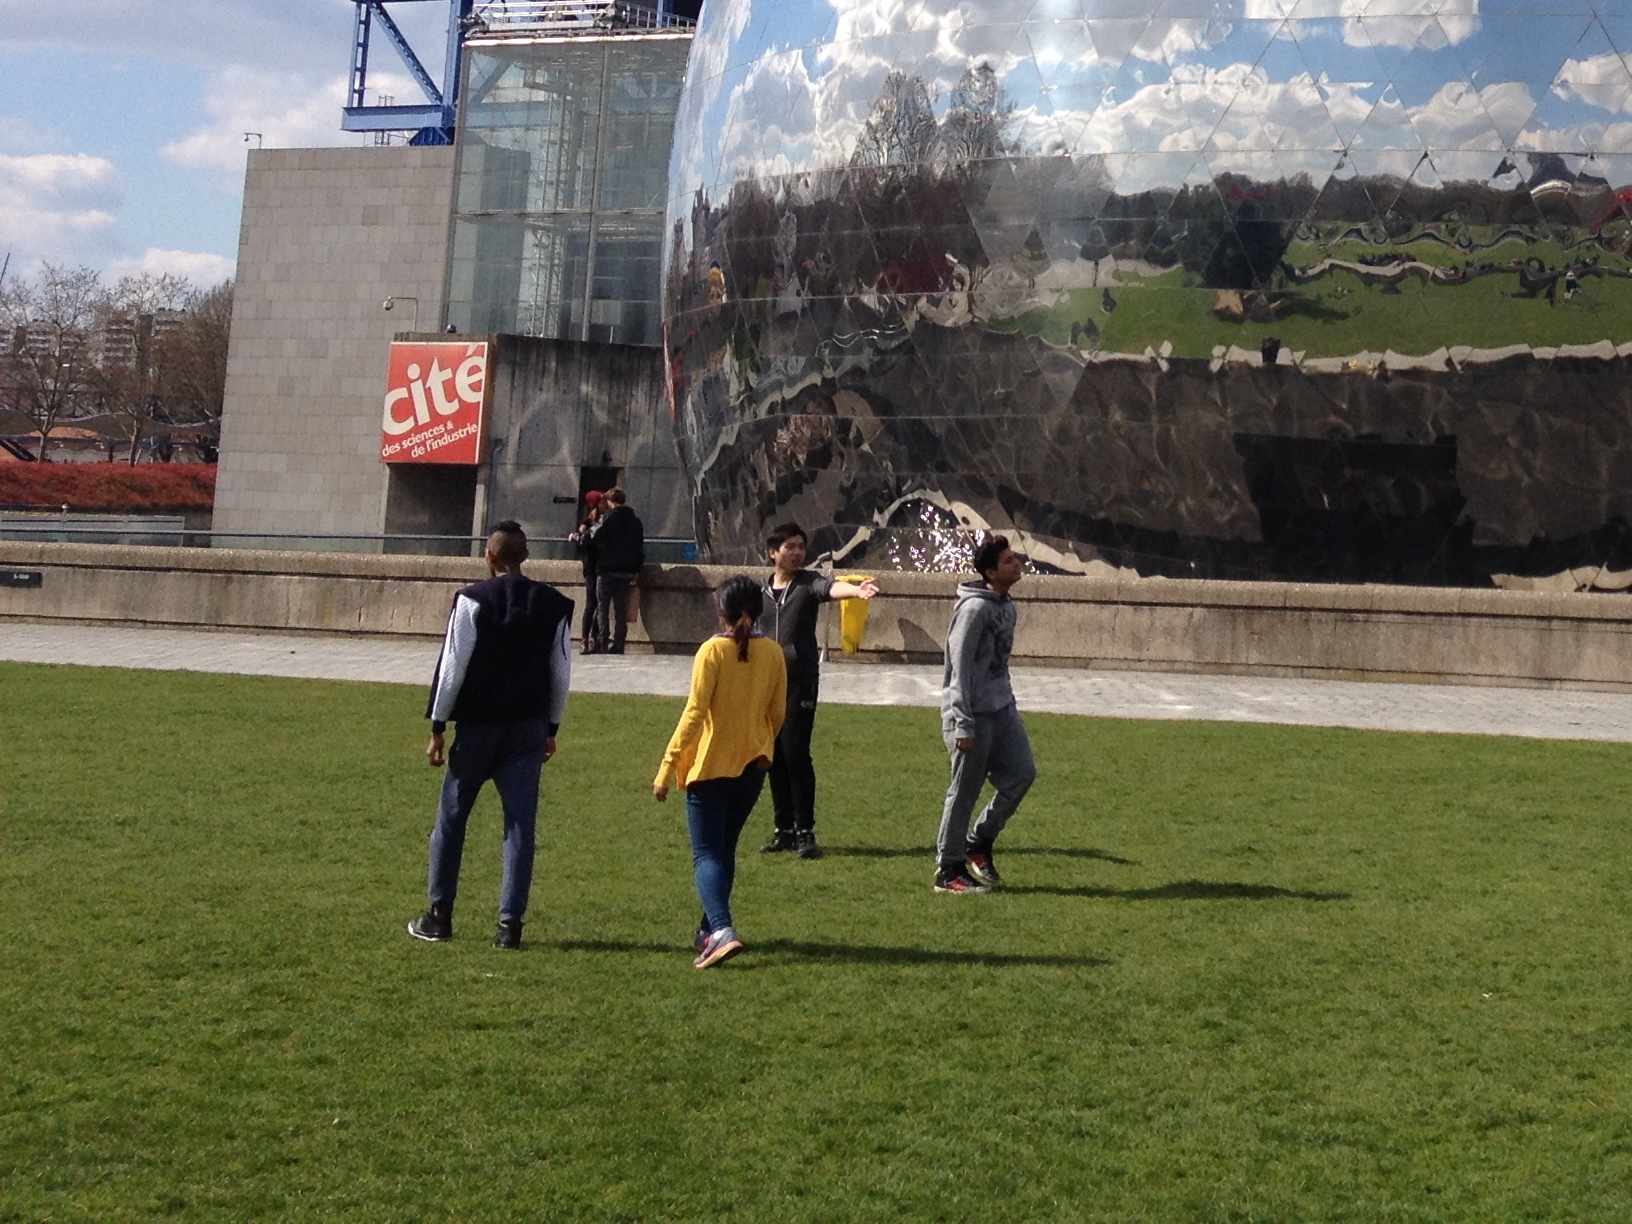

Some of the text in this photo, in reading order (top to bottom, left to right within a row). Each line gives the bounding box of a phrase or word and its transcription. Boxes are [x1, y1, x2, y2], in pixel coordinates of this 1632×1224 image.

[382, 343, 485, 435] cité
[382, 420, 454, 457] des sciences &
[411, 423, 478, 458] de l'industrie
